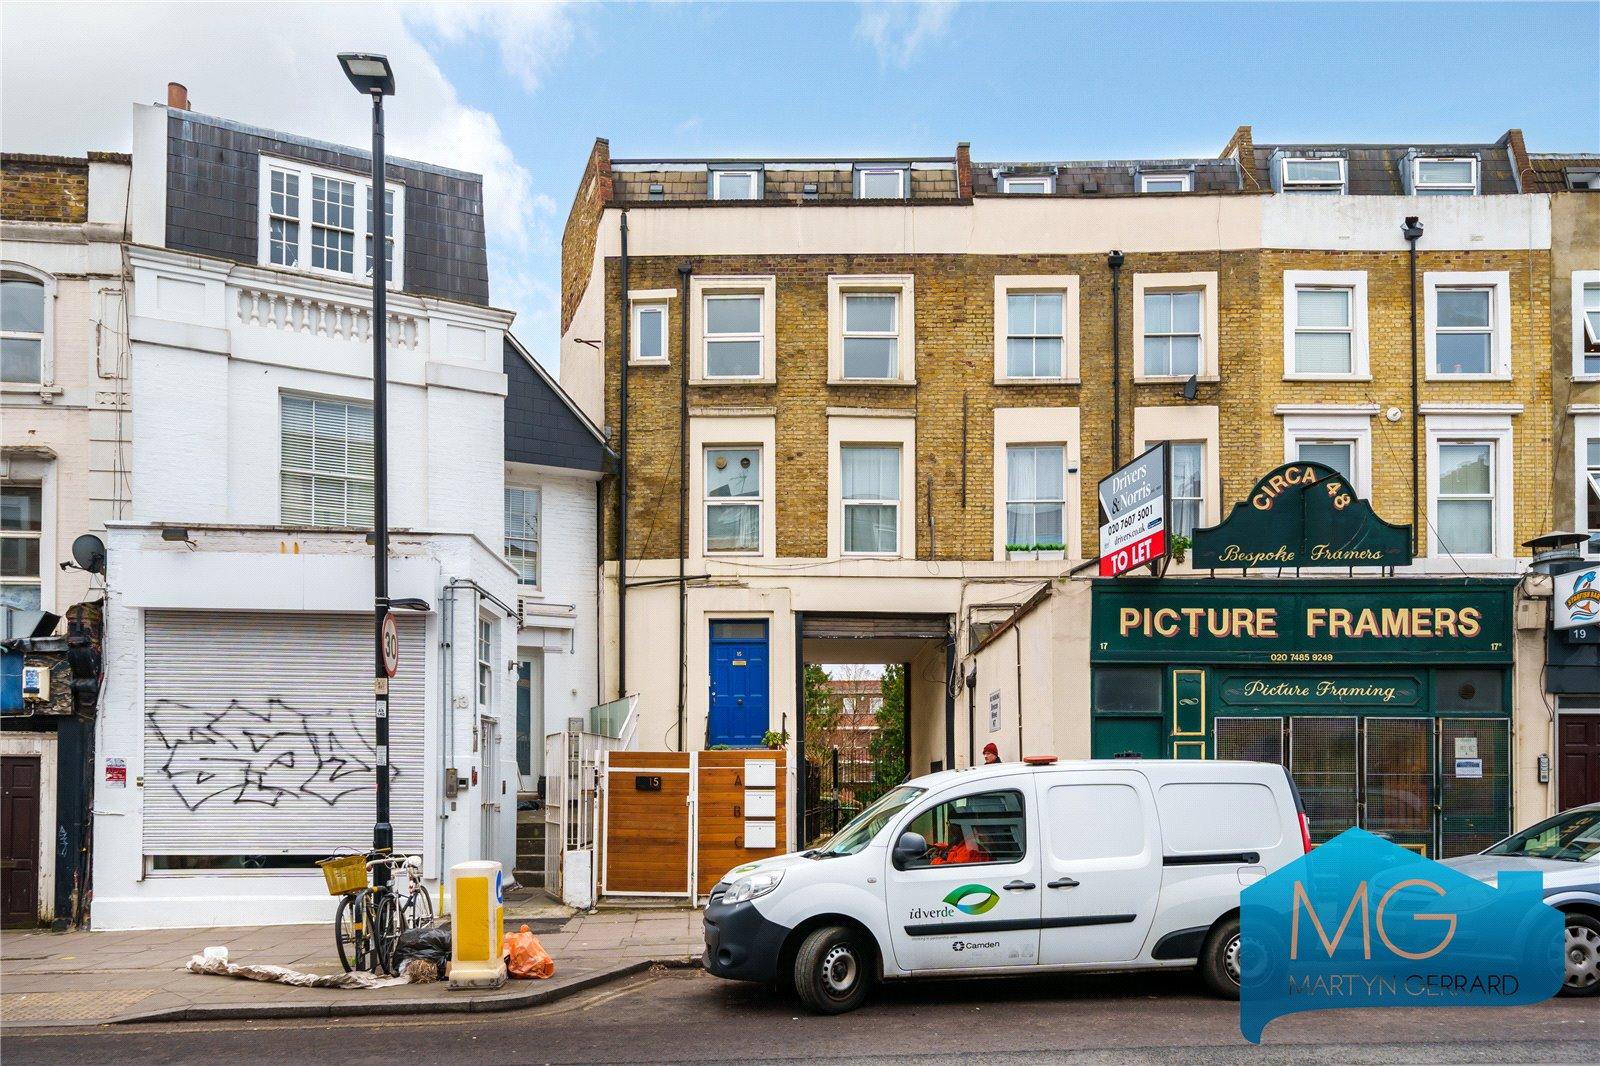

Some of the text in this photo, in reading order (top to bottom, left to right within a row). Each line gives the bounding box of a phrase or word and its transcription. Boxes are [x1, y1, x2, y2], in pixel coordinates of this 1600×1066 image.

[1112, 464, 1147, 495] Drivers
[1252, 466, 1351, 511] CIRCA 48
[1120, 481, 1151, 511] Norris
[1108, 522, 1119, 536] 020
[1120, 513, 1136, 529] 7607
[1137, 504, 1153, 521] 5001
[1114, 525, 1145, 546] drivers.co.uk
[1111, 550, 1128, 574] TO
[1132, 538, 1152, 566] LET
[1218, 543, 1384, 567] Bespoke Framers
[1120, 607, 1482, 639] PICTURE FRAMERS
[1573, 629, 1587, 639] 19
[385, 631, 396, 658] 30
[1099, 642, 1108, 650] 17
[1270, 653, 1334, 662] 020 7485 9249
[1244, 679, 1396, 702] Picture Framing
[734, 774, 742, 787] A
[733, 805, 741, 818] B
[734, 836, 743, 849] C
[966, 941, 1000, 950] Camden
